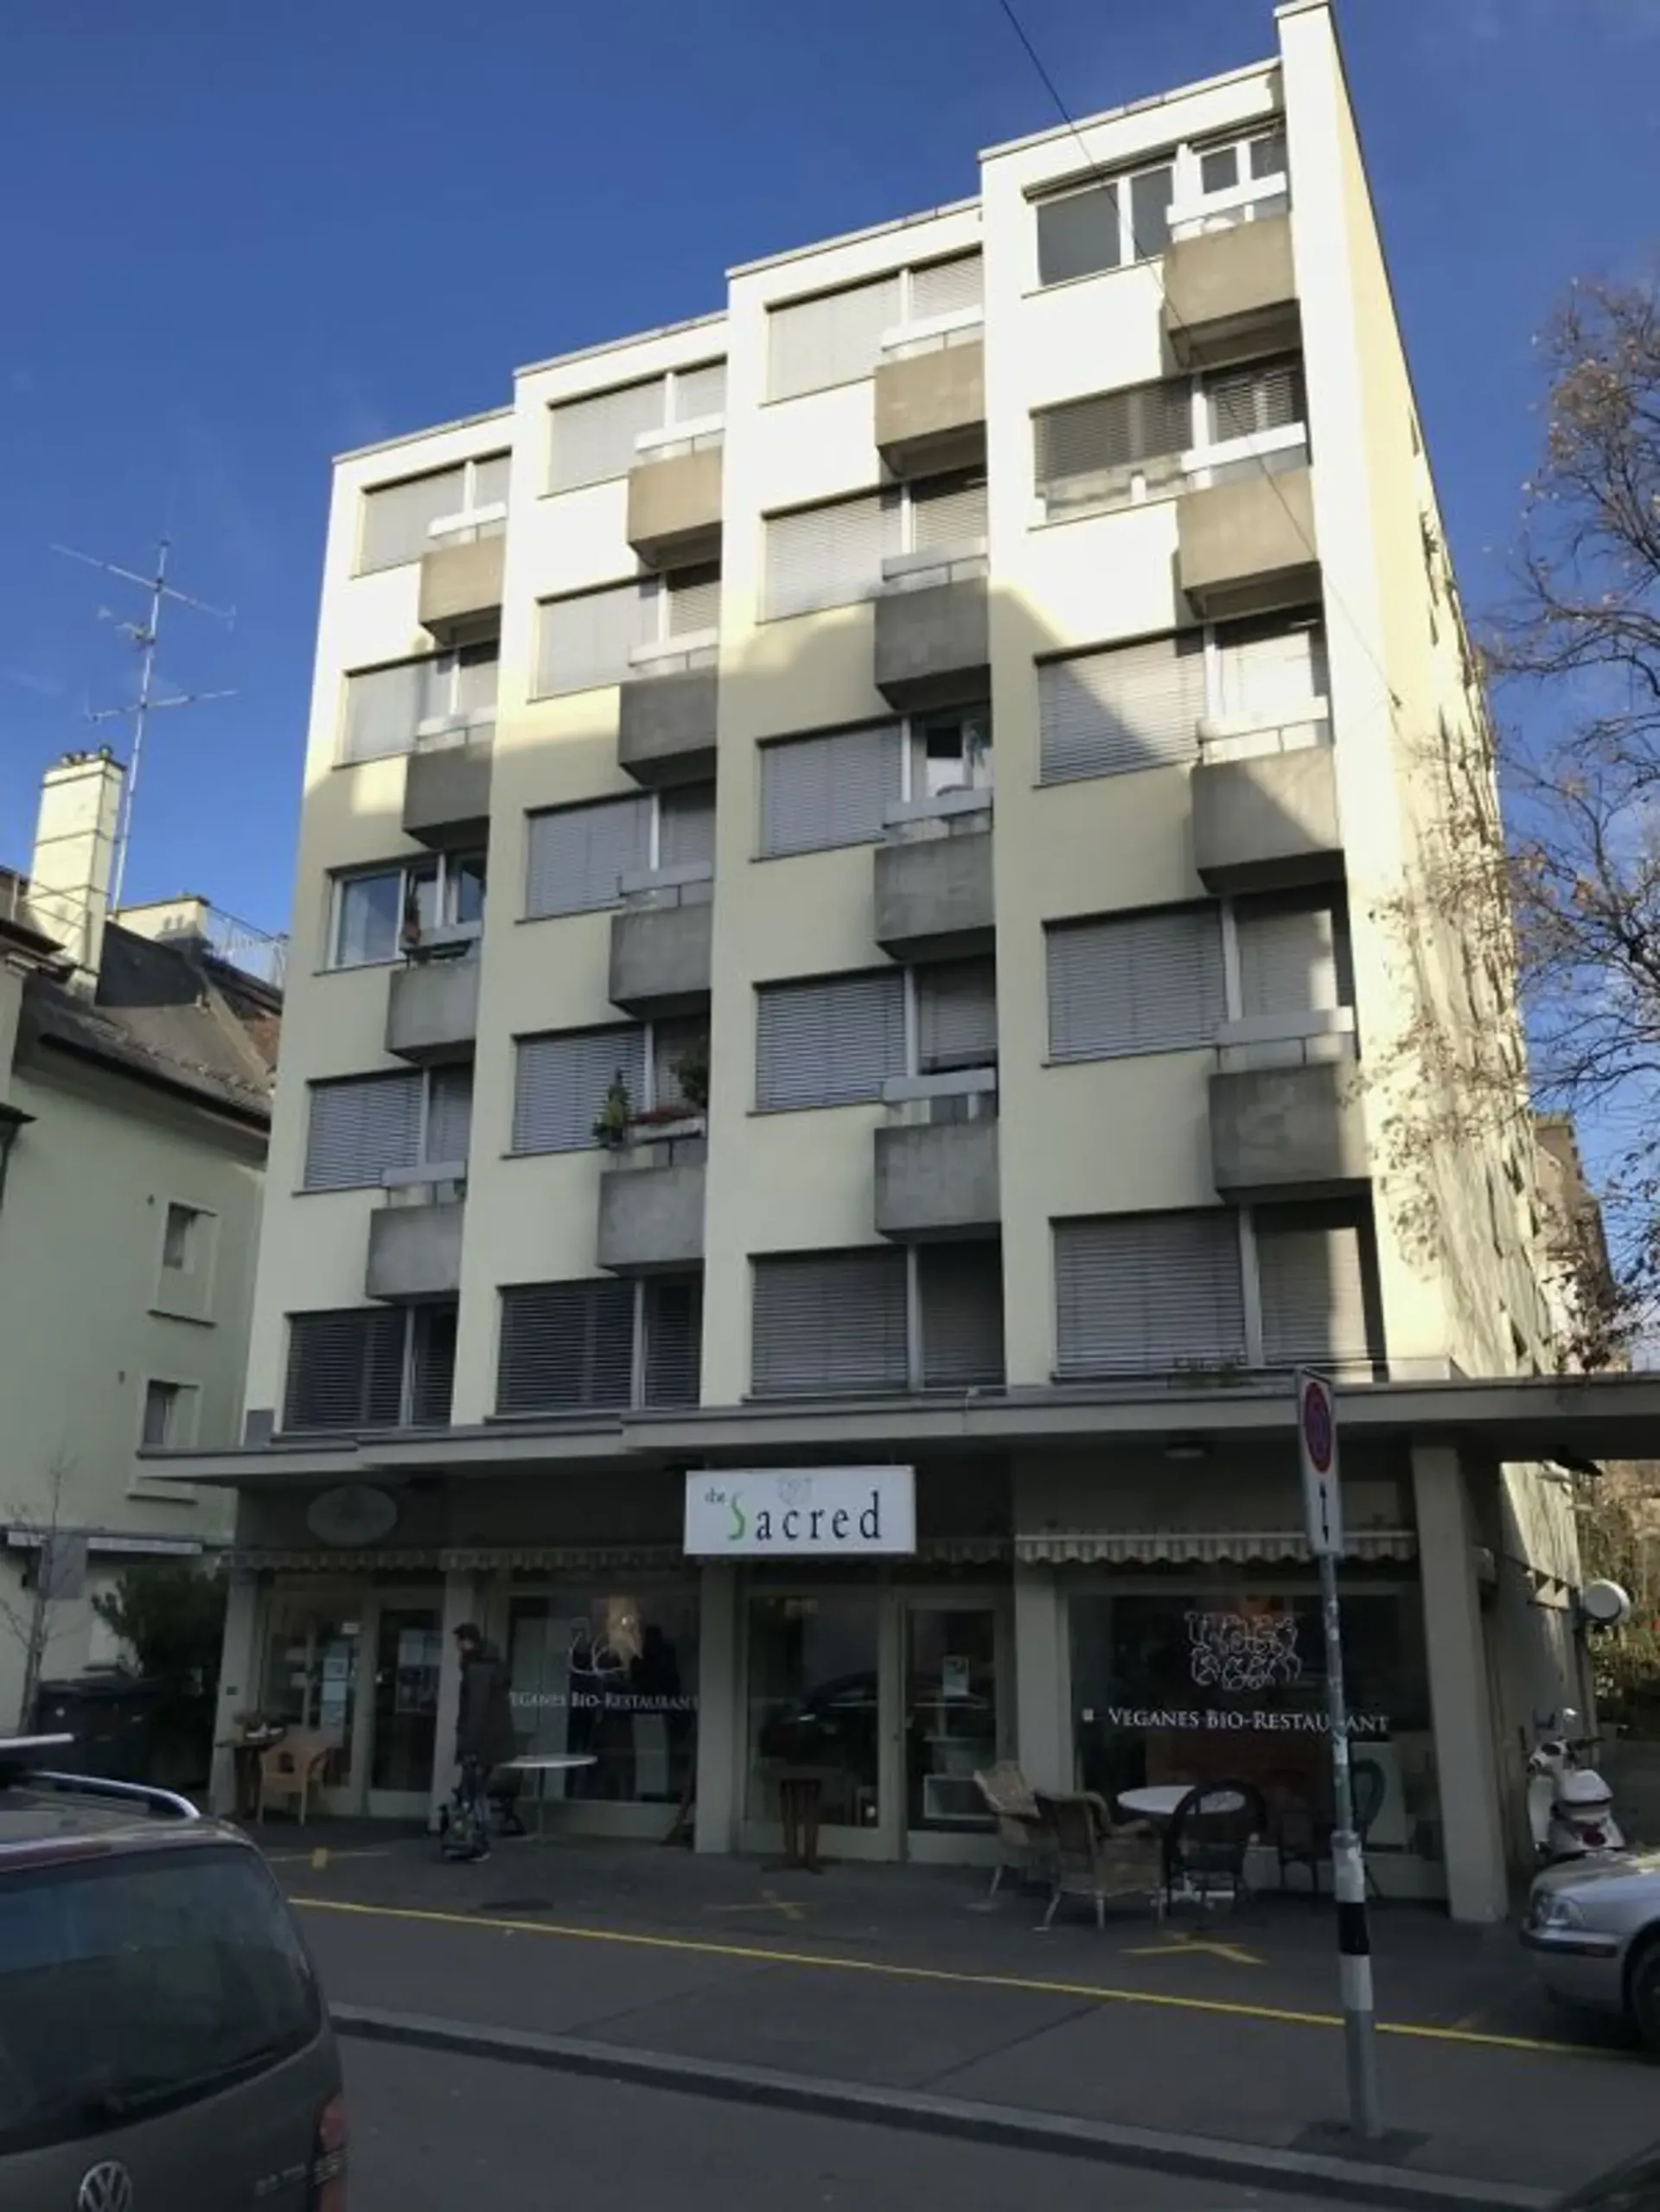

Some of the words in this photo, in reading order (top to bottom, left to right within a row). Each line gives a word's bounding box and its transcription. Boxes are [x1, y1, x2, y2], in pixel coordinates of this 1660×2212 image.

[704, 1487, 725, 1504] the
[728, 1489, 881, 1540] Sacred
[1108, 1707, 1200, 1729] VEGANES
[1206, 1709, 1389, 1732] BIO-RESTAUANT
